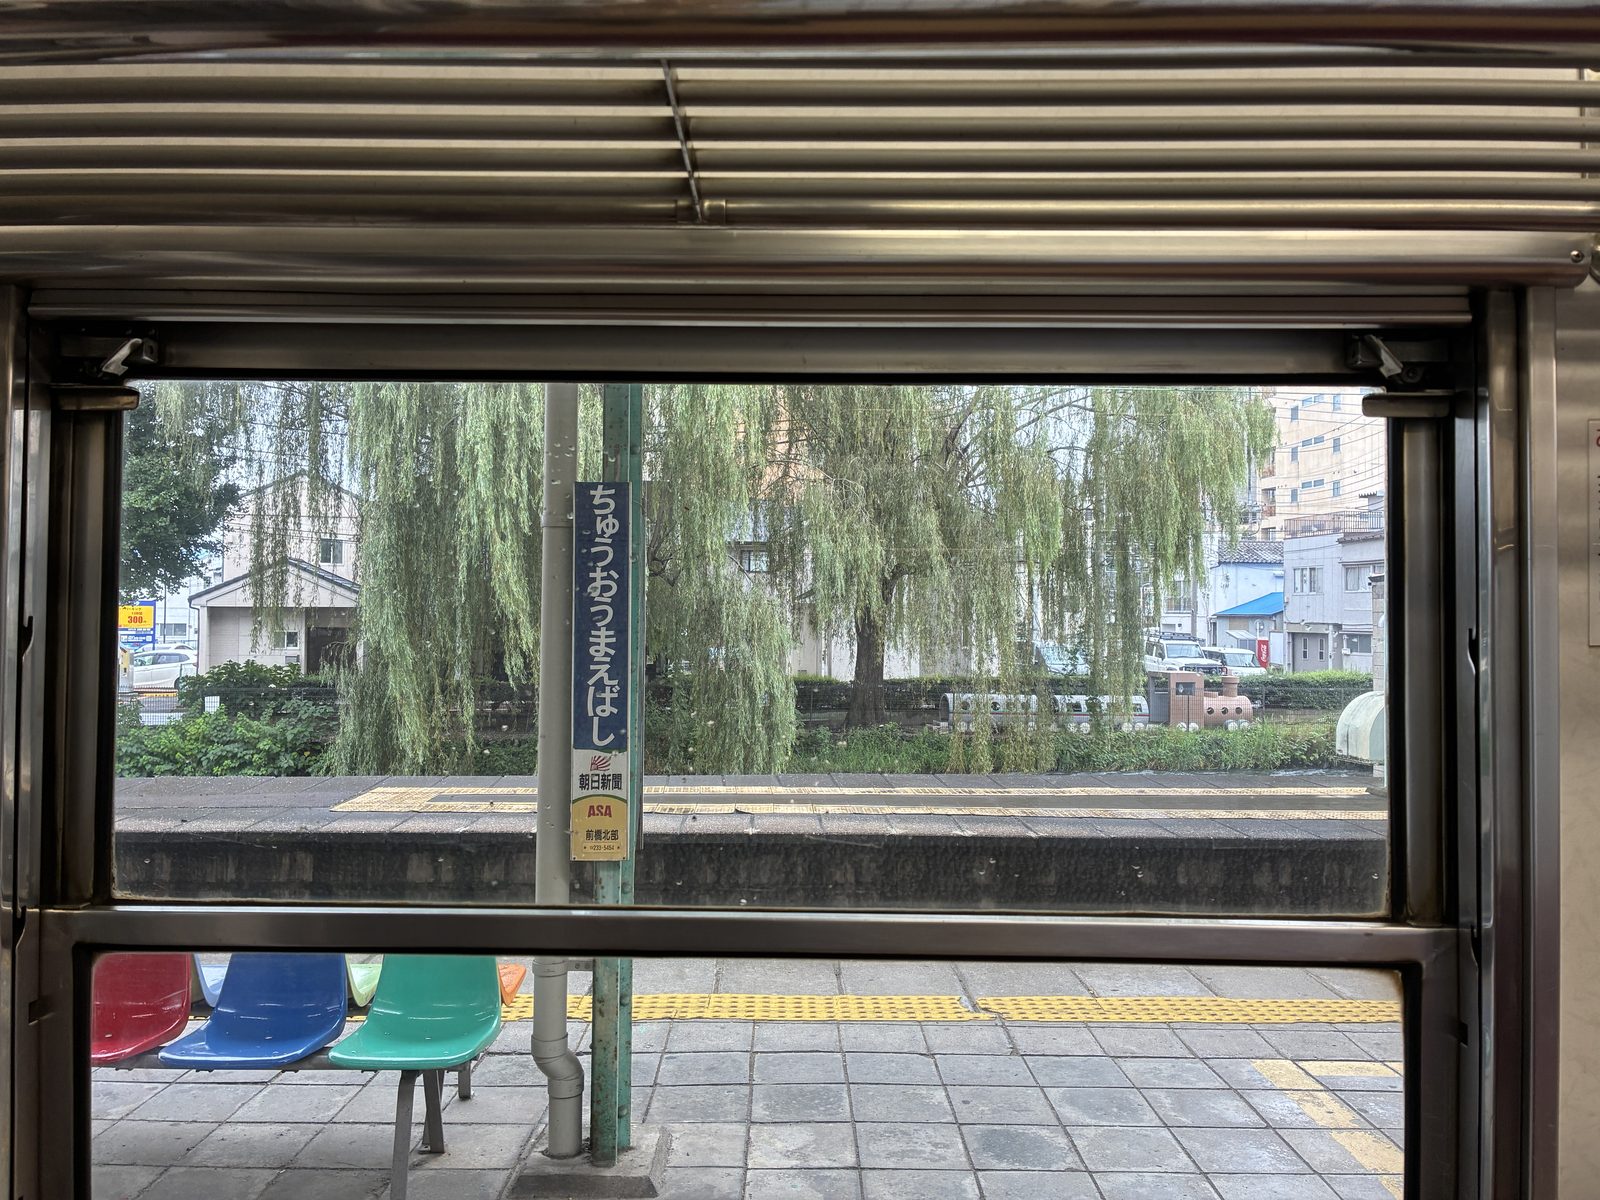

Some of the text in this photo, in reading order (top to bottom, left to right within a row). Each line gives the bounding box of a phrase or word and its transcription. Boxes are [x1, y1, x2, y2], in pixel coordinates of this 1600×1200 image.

[587, 484, 620, 746] ちゅうおうまえばし
[579, 773, 622, 790] 朝日新聞
[587, 805, 612, 817] ASA
[586, 829, 619, 840] 前橋北部
